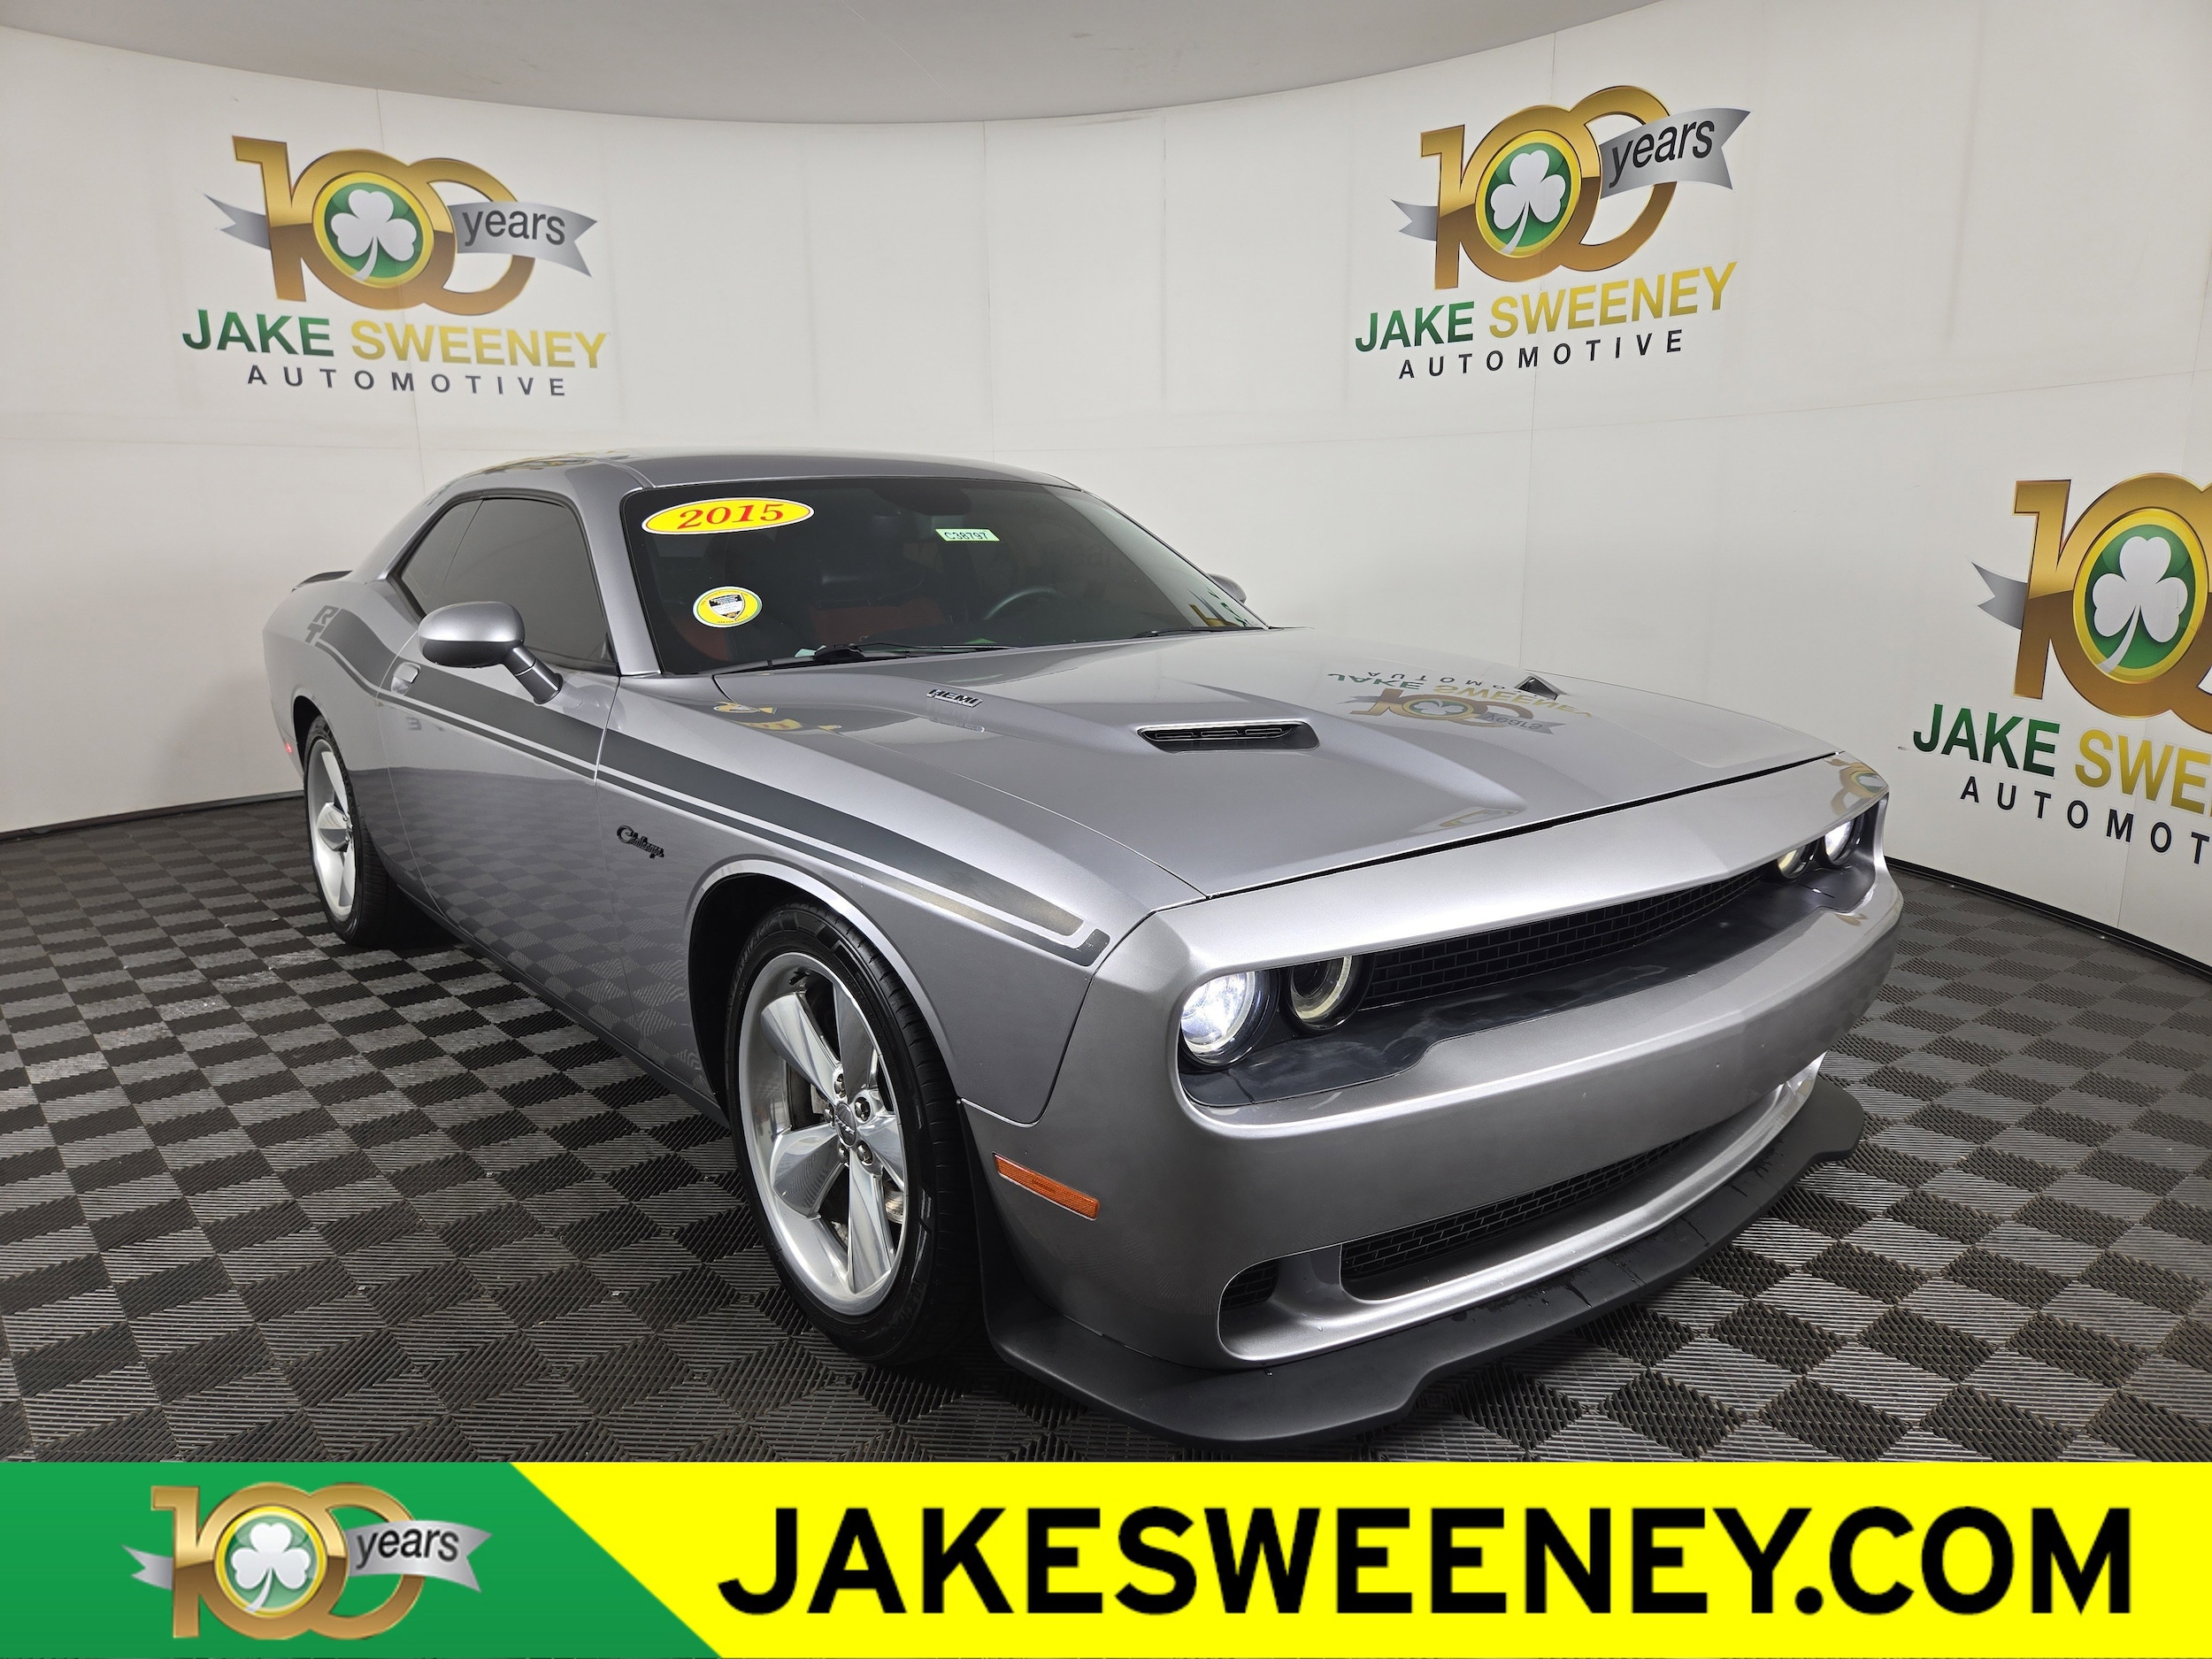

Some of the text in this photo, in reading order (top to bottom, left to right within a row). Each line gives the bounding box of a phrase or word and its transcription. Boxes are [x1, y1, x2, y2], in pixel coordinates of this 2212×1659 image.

[1420, 85, 1716, 290] 100 years
[232, 135, 566, 316] 100 years
[181, 310, 608, 369] JAKE SWEENEY
[1355, 262, 1738, 352] JAKE SWEENEY
[247, 365, 566, 396] AUTOMOTIVE
[1398, 329, 1683, 380] AUTOMOTIVE
[677, 503, 784, 530] 2015
[926, 688, 983, 708] HEMI
[1913, 703, 2212, 818] JAKE SWE
[1960, 775, 2210, 864] AUTOMOT
